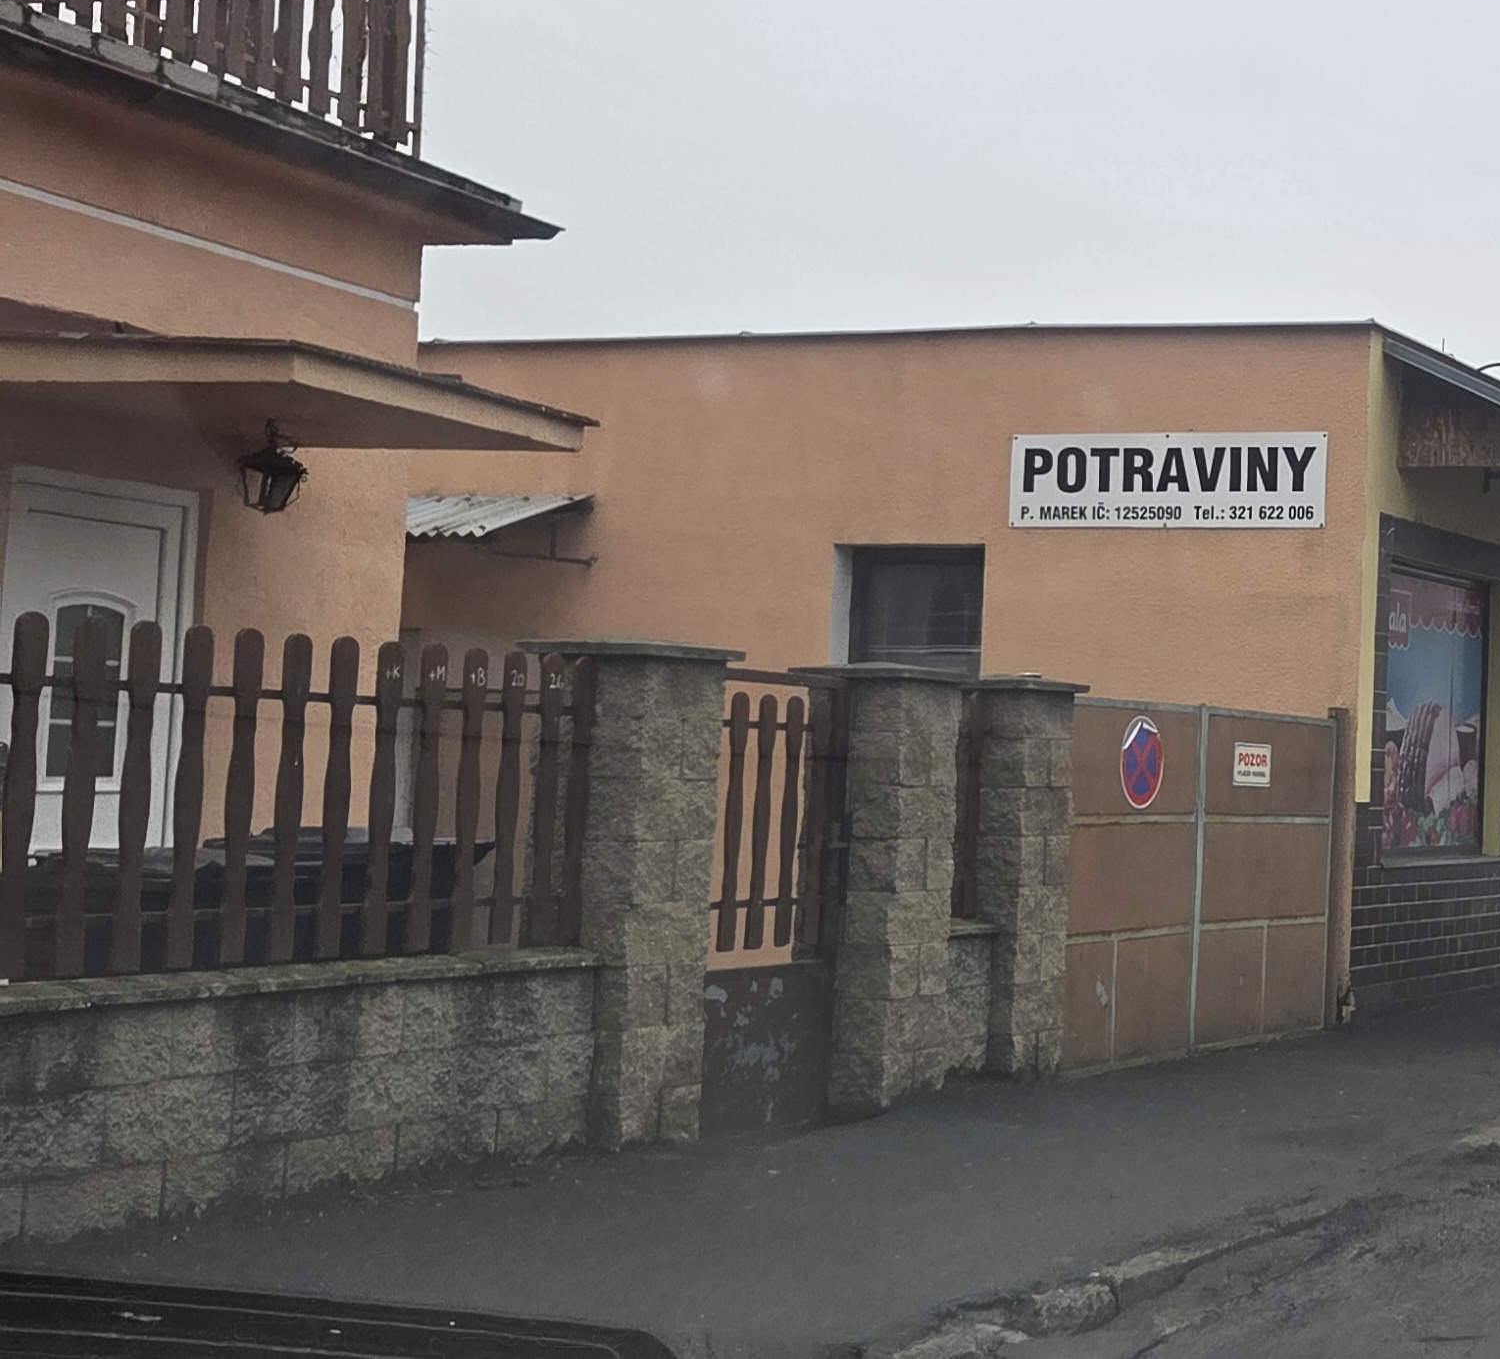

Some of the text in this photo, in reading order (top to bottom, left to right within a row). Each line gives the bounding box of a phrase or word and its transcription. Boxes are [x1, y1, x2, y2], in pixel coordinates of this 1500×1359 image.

[1022, 446, 1317, 493] POTRAVINY
[1021, 505, 1034, 520] P.
[1039, 505, 1088, 521] MAREK
[1114, 505, 1182, 521] 12525090
[1194, 505, 1225, 521] Tel.:
[1229, 505, 1253, 520] 321
[1259, 505, 1284, 520] 622
[1288, 505, 1314, 521] 006
[1238, 752, 1268, 767] POZOR
